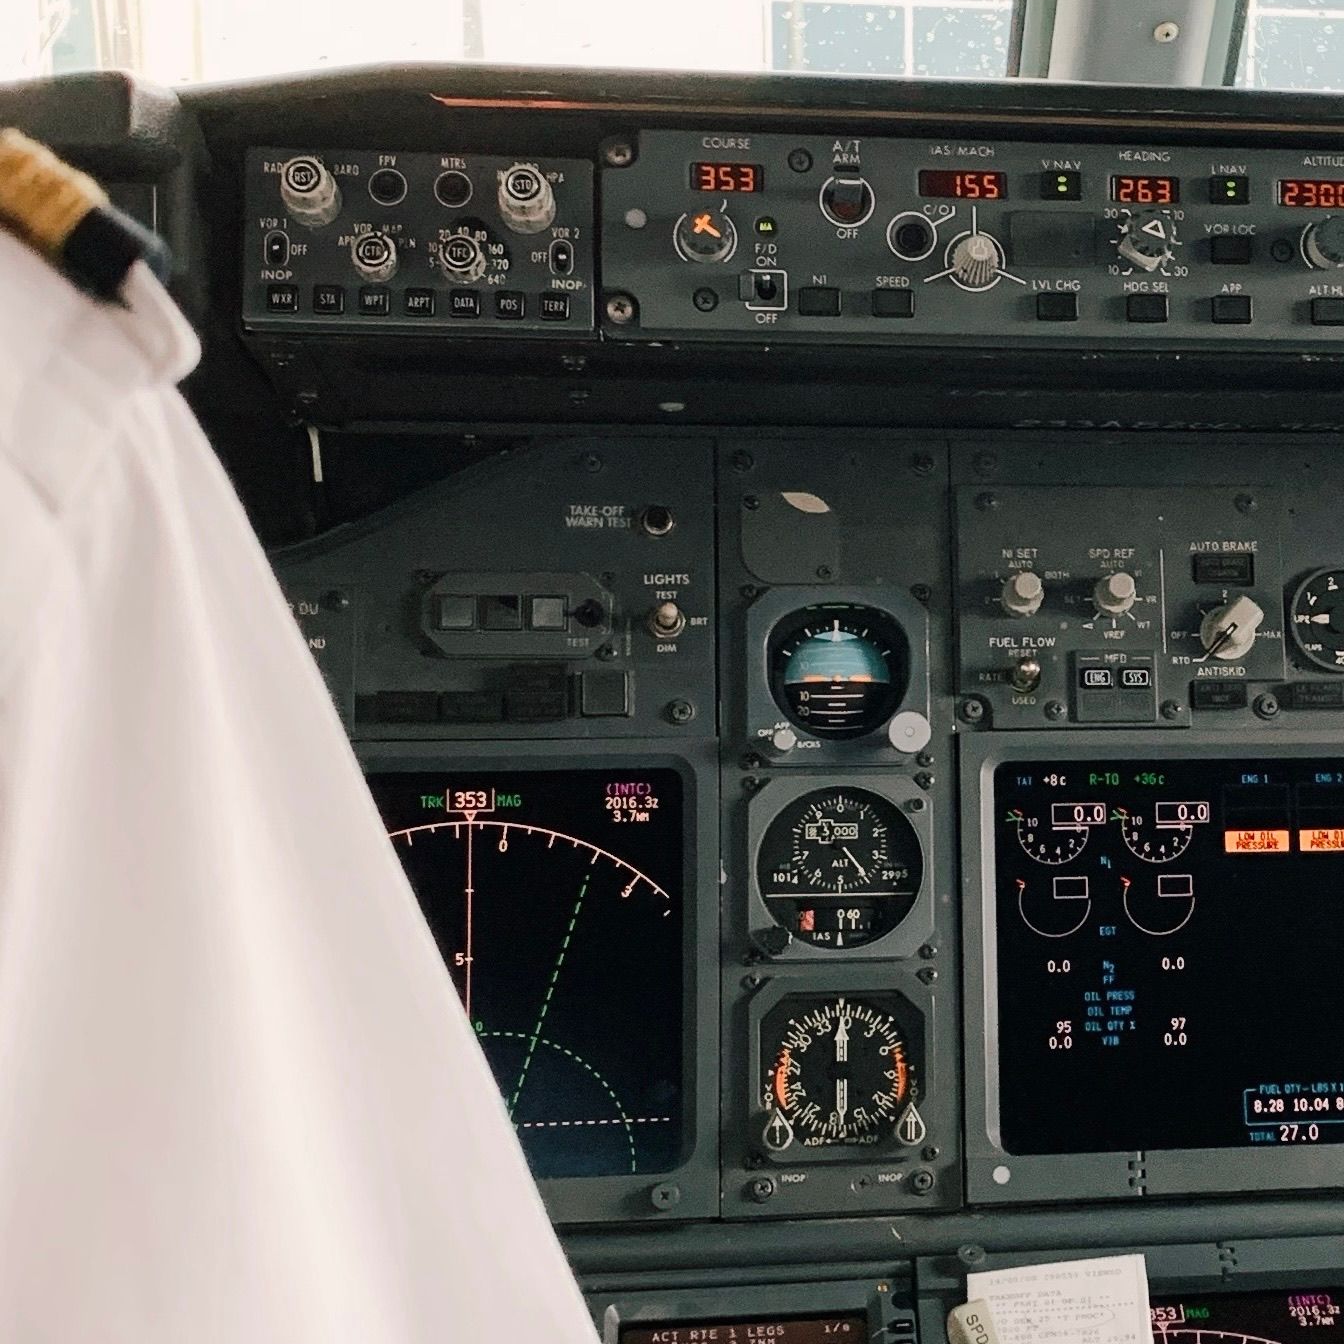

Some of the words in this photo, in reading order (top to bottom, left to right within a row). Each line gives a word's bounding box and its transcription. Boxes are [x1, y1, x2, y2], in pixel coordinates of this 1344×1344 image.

[702, 137, 750, 150] COURSE
[833, 141, 861, 154] A/T
[833, 153, 861, 164] ARM
[1118, 151, 1170, 162] HEADING
[700, 166, 754, 192] 353
[954, 175, 999, 197] 155
[1120, 180, 1170, 202] 263
[836, 228, 859, 239] OFF
[262, 270, 292, 281] INOP
[876, 275, 909, 288] SPEED
[1032, 280, 1052, 291] LVL
[1056, 280, 1081, 291] CHG
[1124, 282, 1147, 293] HDG
[1150, 282, 1169, 293] SEL
[272, 293, 292, 304] WXR
[320, 293, 335, 304] STA
[1190, 541, 1218, 552] AUTO
[1222, 541, 1258, 552] BRAKE
[644, 574, 690, 584] LIGHTS
[989, 638, 1017, 648] FUEL
[1022, 637, 1056, 648] FLOW
[1197, 666, 1246, 678] ANTISKID
[606, 782, 652, 796] (INTC)
[421, 795, 444, 809] TRK
[455, 791, 488, 808] 353
[497, 794, 521, 808] MAG
[1254, 1099, 1284, 1114] 8.28
[1293, 1098, 1330, 1113] 10.04
[1279, 1125, 1319, 1141] 27.0
[652, 1332, 679, 1342] ACT
[690, 1329, 719, 1340] RTE
[729, 1329, 737, 1338] 1
[748, 1325, 785, 1337] LEGS
